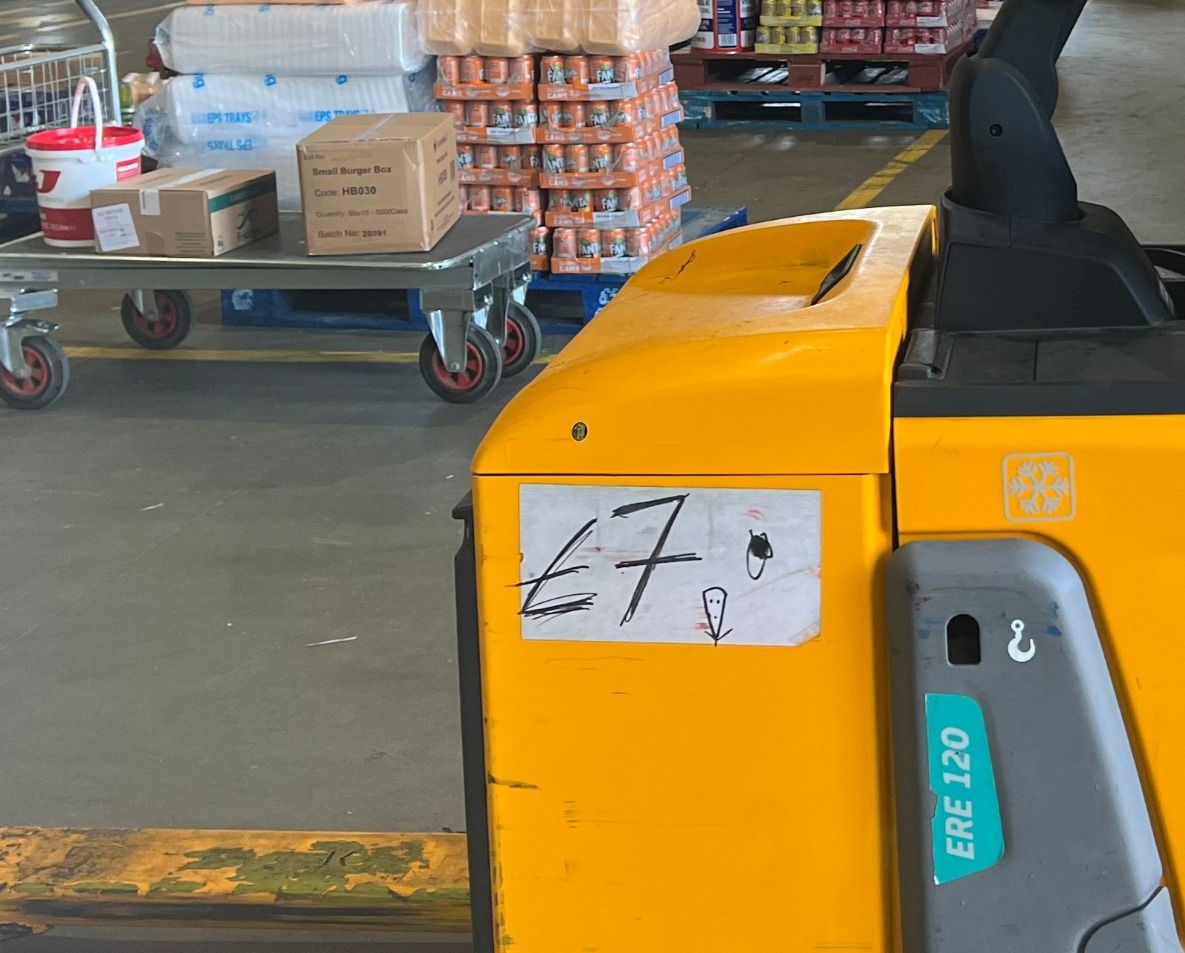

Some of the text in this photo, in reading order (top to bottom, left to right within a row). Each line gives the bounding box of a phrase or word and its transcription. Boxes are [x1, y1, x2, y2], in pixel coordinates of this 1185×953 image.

[207, 112, 251, 123] EPS TRAYS
[314, 111, 331, 122] EPS
[312, 165, 392, 176] Small Burger Box
[341, 186, 377, 196] HB030
[318, 230, 343, 239] Batch
[940, 726, 975, 860] ERE 120
